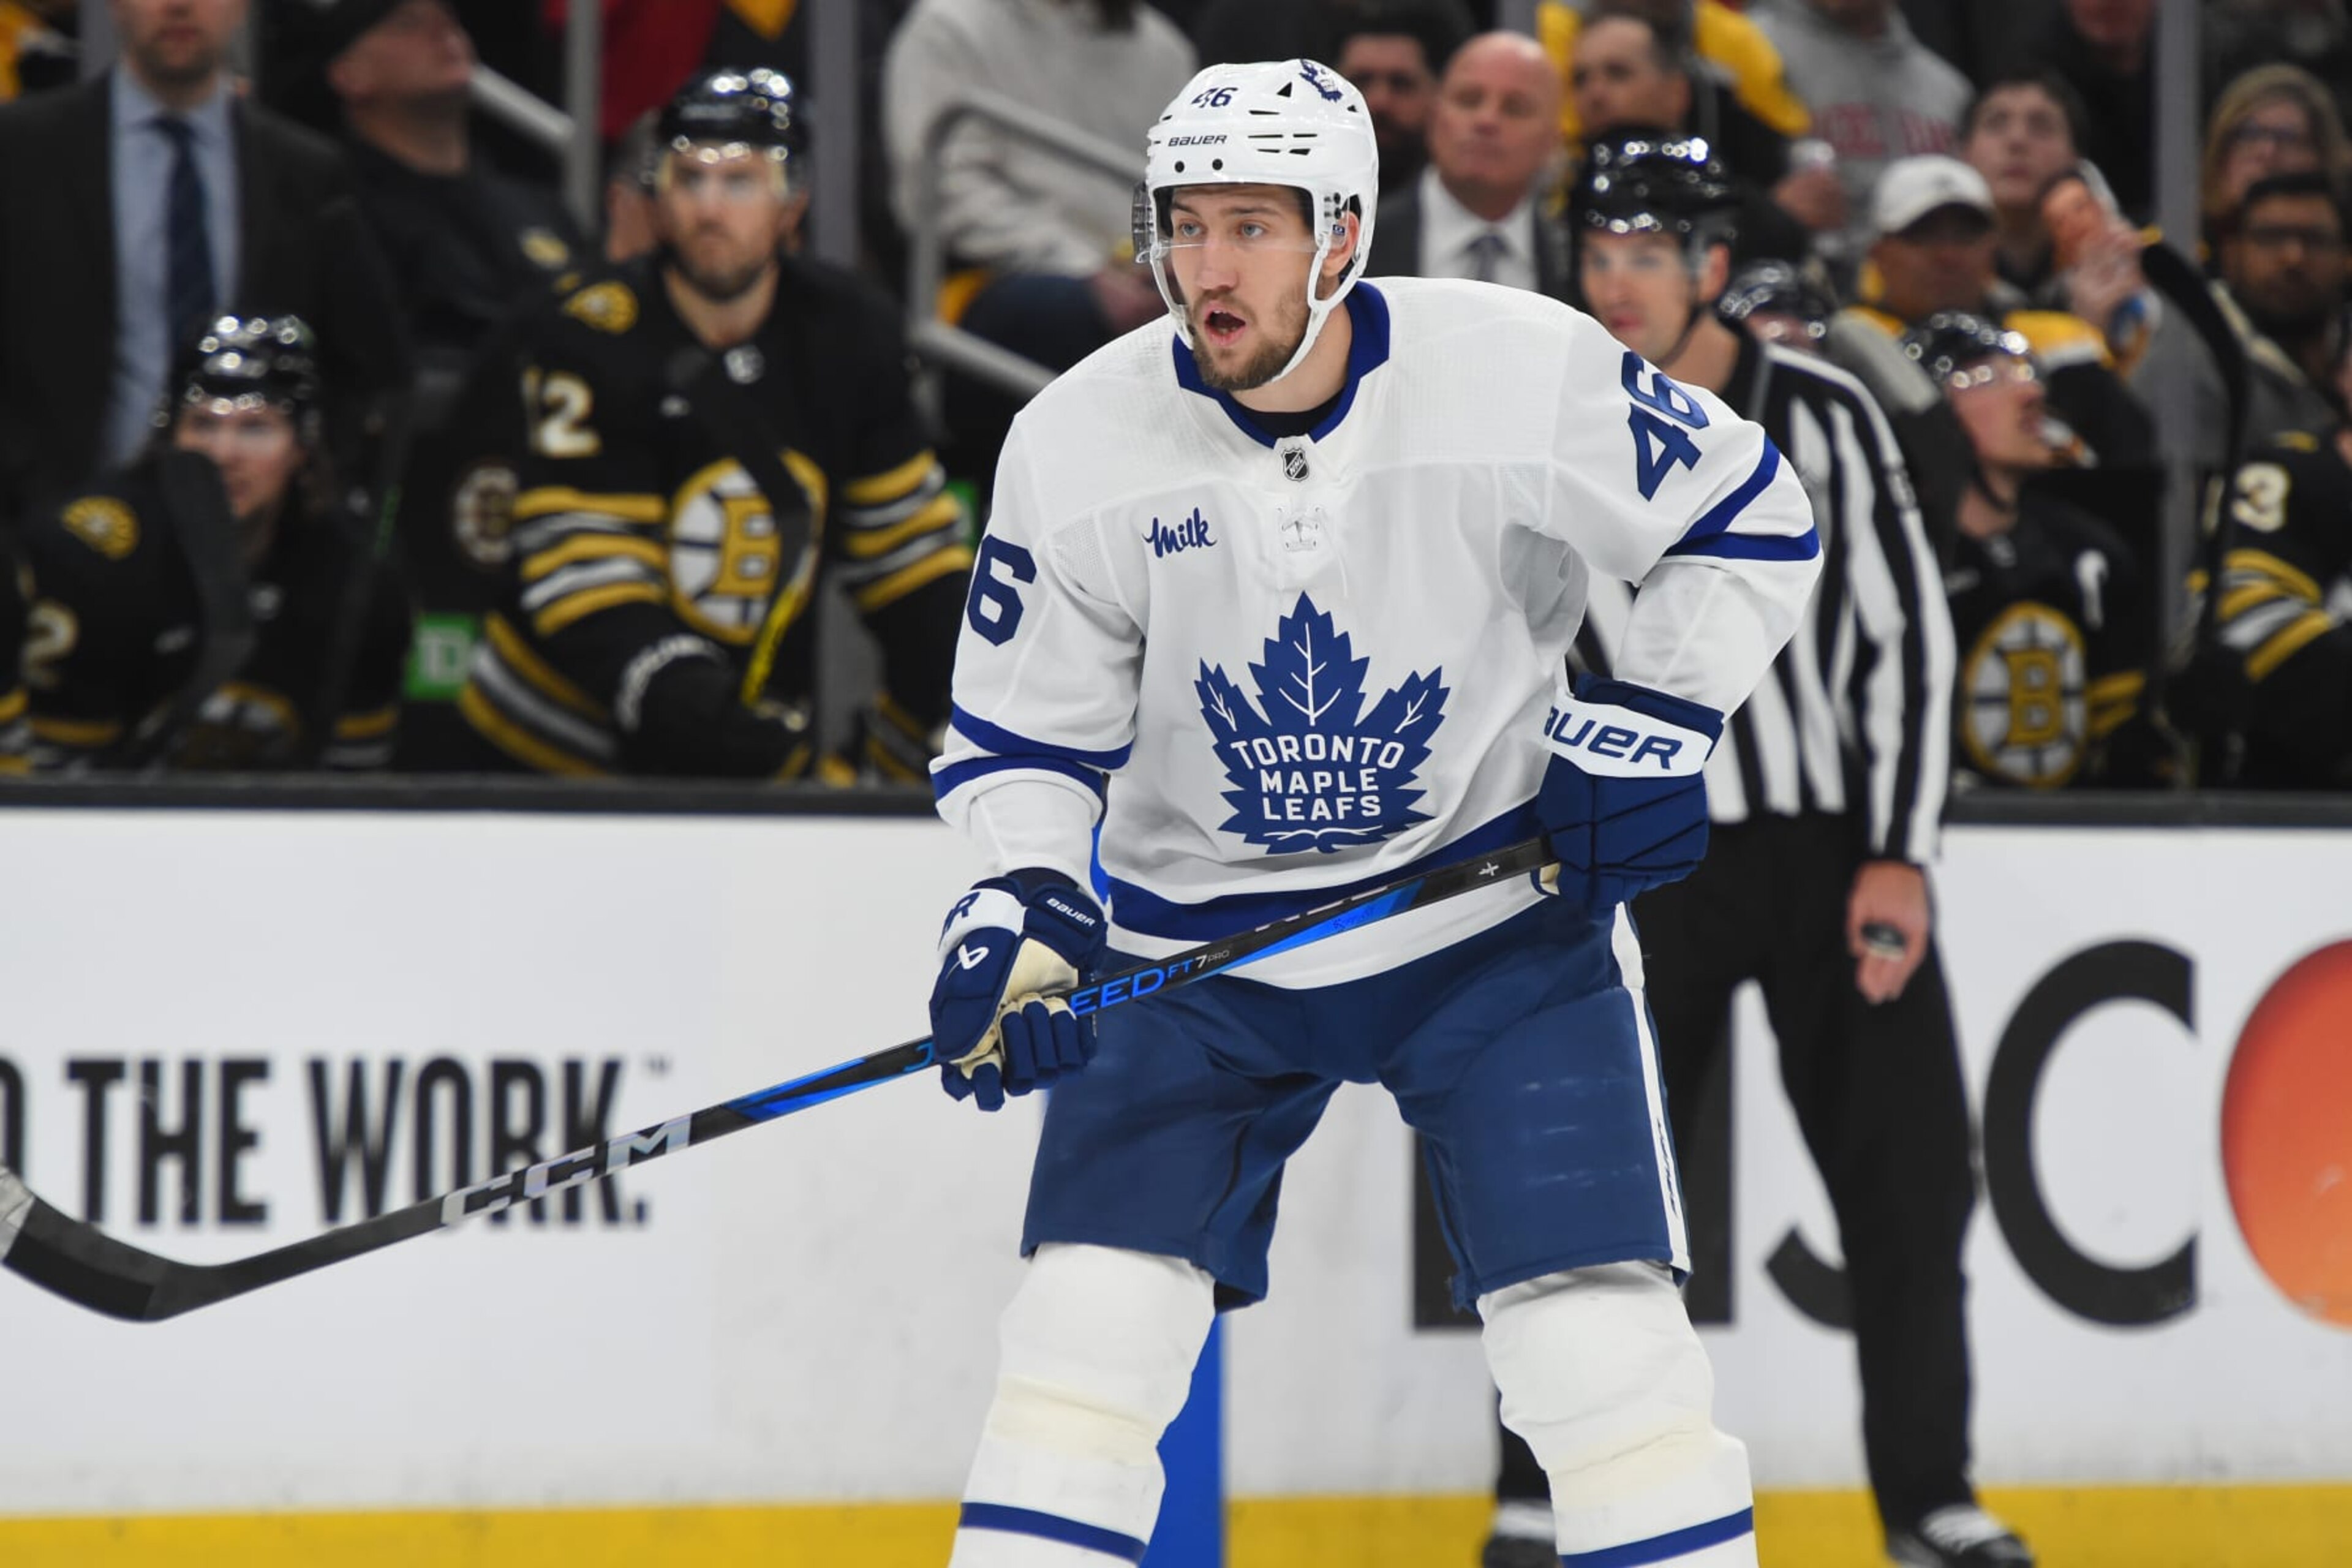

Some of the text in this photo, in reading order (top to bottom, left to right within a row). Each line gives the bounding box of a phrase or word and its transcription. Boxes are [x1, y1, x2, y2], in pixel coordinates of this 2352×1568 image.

[1191, 87, 1238, 108] 46
[1168, 134, 1227, 147] BAUER
[1621, 350, 1710, 502] 46
[1231, 733, 1405, 770] TORONTO
[1259, 767, 1379, 794] MAPLE
[1262, 794, 1381, 821] LEAFS
[1069, 966, 1165, 1016] EED
[67, 1055, 270, 1224] THE
[442, 1113, 693, 1225] CCM
